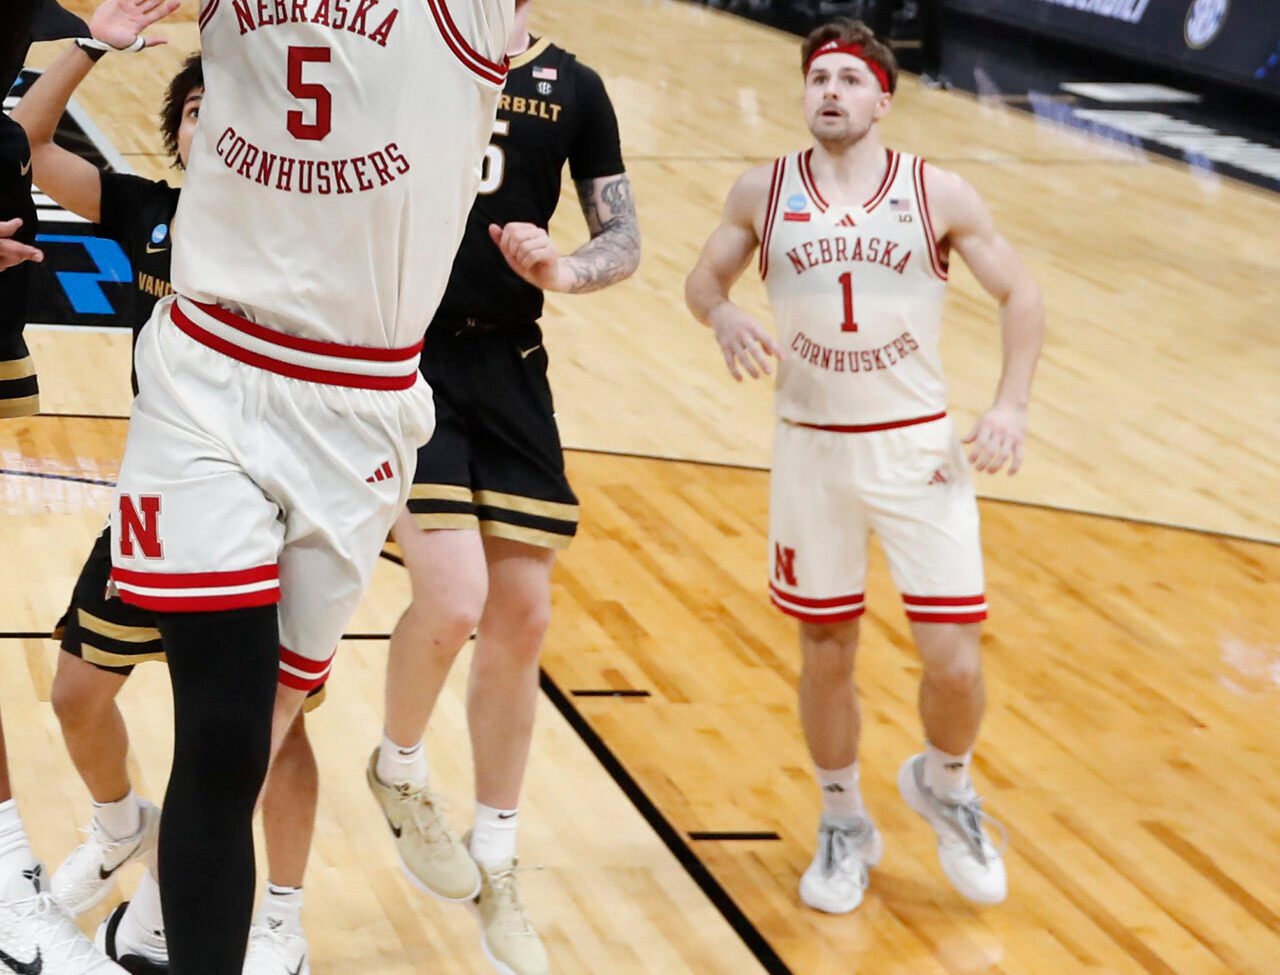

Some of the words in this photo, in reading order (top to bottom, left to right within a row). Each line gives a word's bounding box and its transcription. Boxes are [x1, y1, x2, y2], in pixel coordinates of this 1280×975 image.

[286, 45, 332, 141] 5
[216, 126, 410, 195] CORNHUSKERS
[786, 236, 912, 275] NEBRASKA
[838, 271, 858, 333] 1
[791, 331, 919, 373] CORNHUSKERS
[119, 492, 165, 560] N
[775, 541, 798, 587] N
